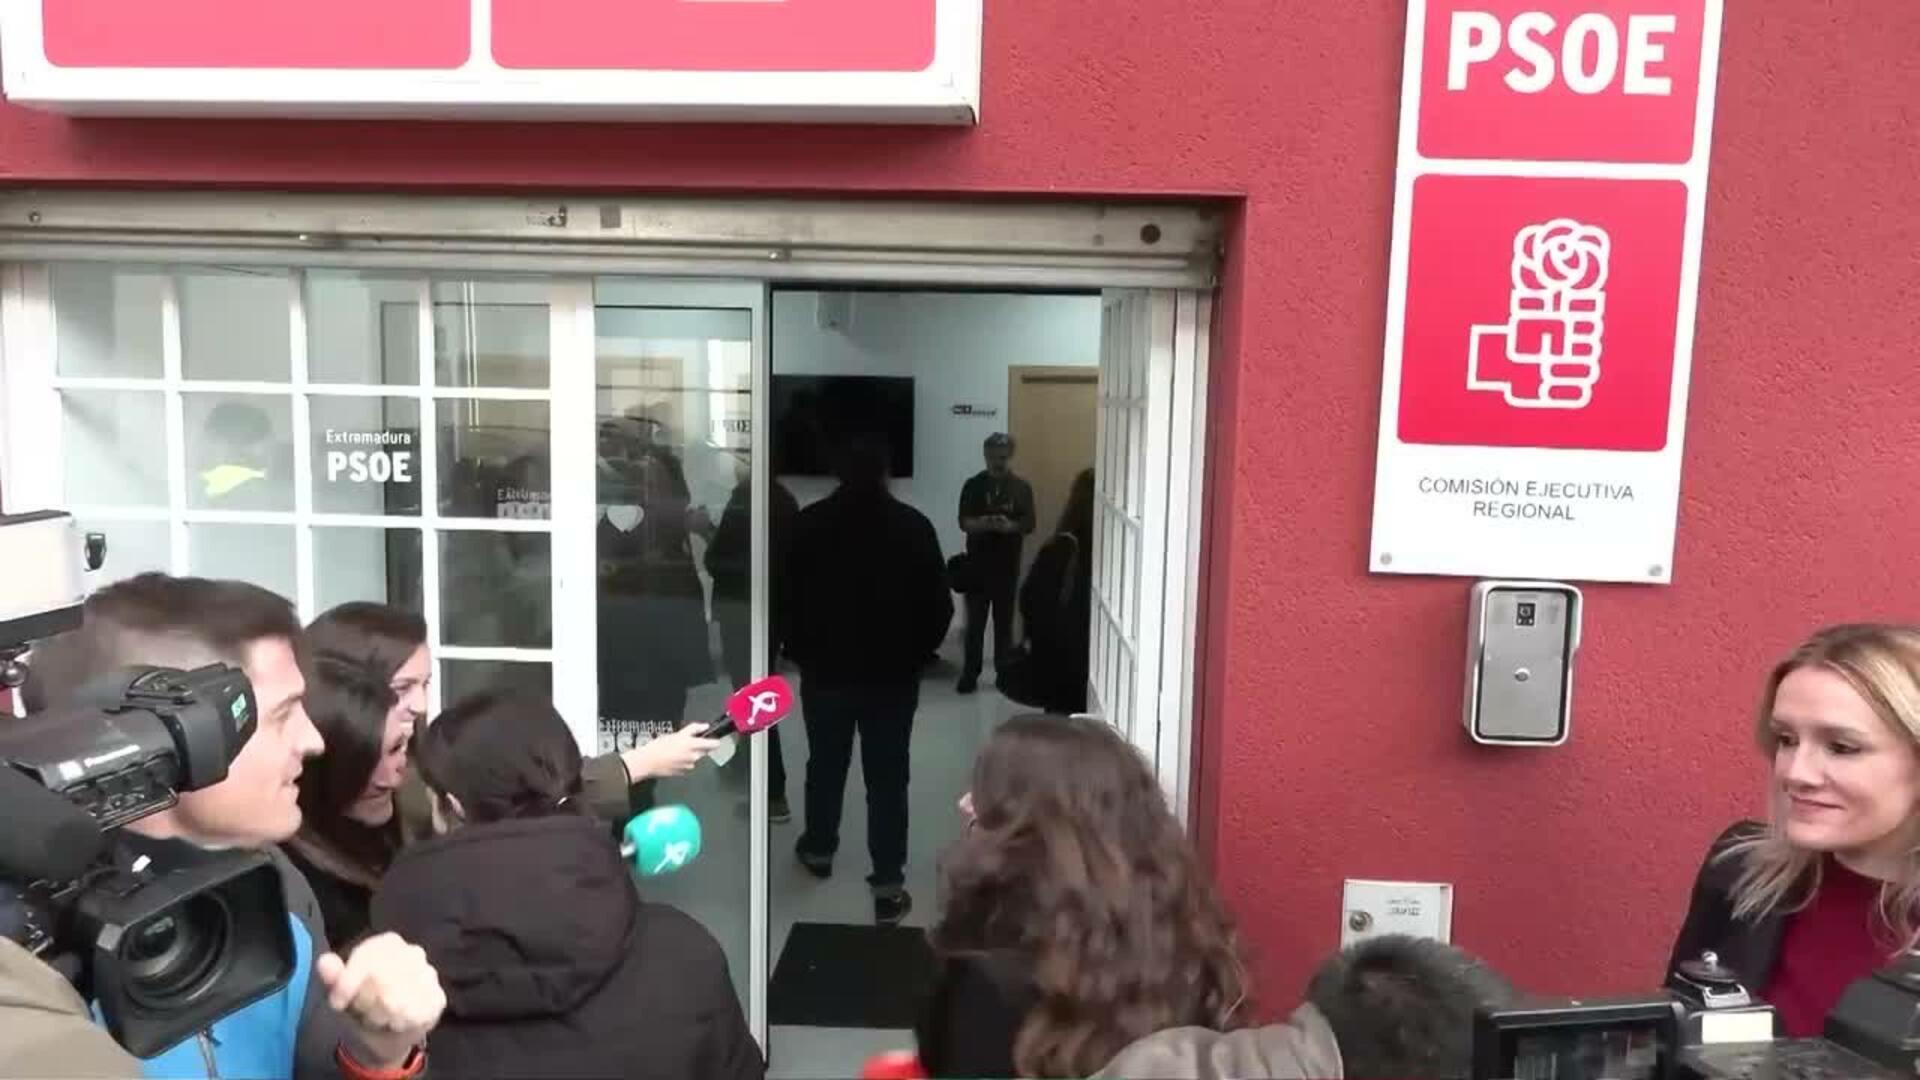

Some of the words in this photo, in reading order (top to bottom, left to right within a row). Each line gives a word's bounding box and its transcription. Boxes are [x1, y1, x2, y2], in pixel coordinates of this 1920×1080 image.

[1447, 11, 1677, 95] PSOE
[326, 429, 412, 444] Extremadura
[327, 450, 412, 482] PSOE
[1418, 476, 1519, 497] COMISIÓN
[1525, 480, 1634, 500] EJECUTIVA
[1473, 501, 1576, 521] REGIONAL
